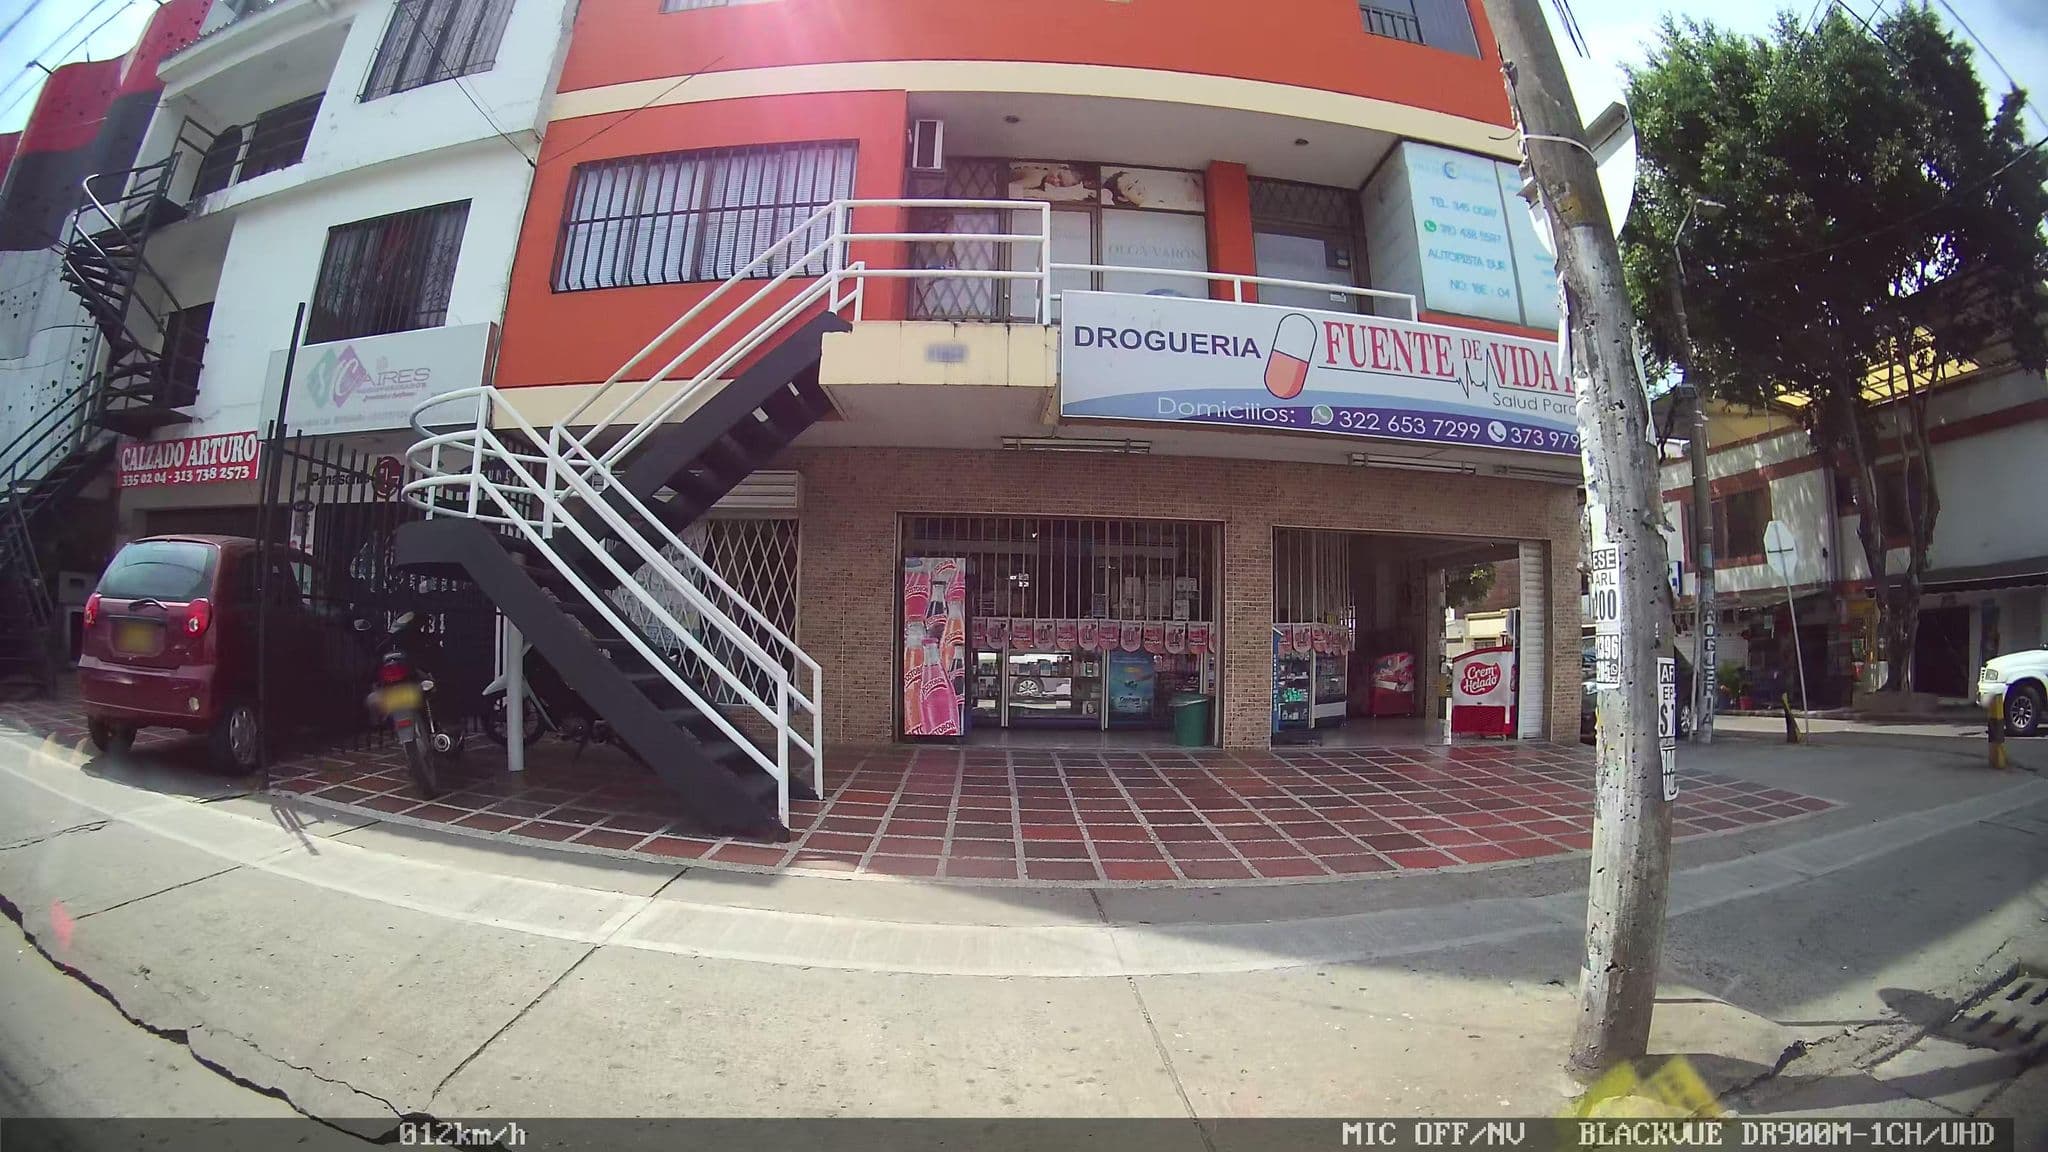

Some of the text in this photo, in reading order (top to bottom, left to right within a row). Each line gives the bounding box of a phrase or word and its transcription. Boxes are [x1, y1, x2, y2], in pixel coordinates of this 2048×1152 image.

[1074, 325, 1262, 359] DROGUERIA
[1323, 320, 1559, 393] FUENTE DE VIDA
[1158, 397, 1296, 424] Domicilios:
[1493, 391, 1538, 411] Salud
[1339, 410, 1381, 431] 322
[1387, 414, 1426, 436] 653
[1433, 418, 1481, 440] 7299
[1510, 427, 1545, 447] 373
[121, 433, 258, 472] CALZADO ARTURO
[121, 475, 139, 487] 335
[141, 473, 152, 484] 02
[154, 471, 166, 484] 04
[174, 469, 193, 482] 313
[196, 467, 217, 481] 738
[220, 465, 250, 480] 2573
[1463, 674, 1497, 693] Helado
[1467, 665, 1495, 680] Crem
